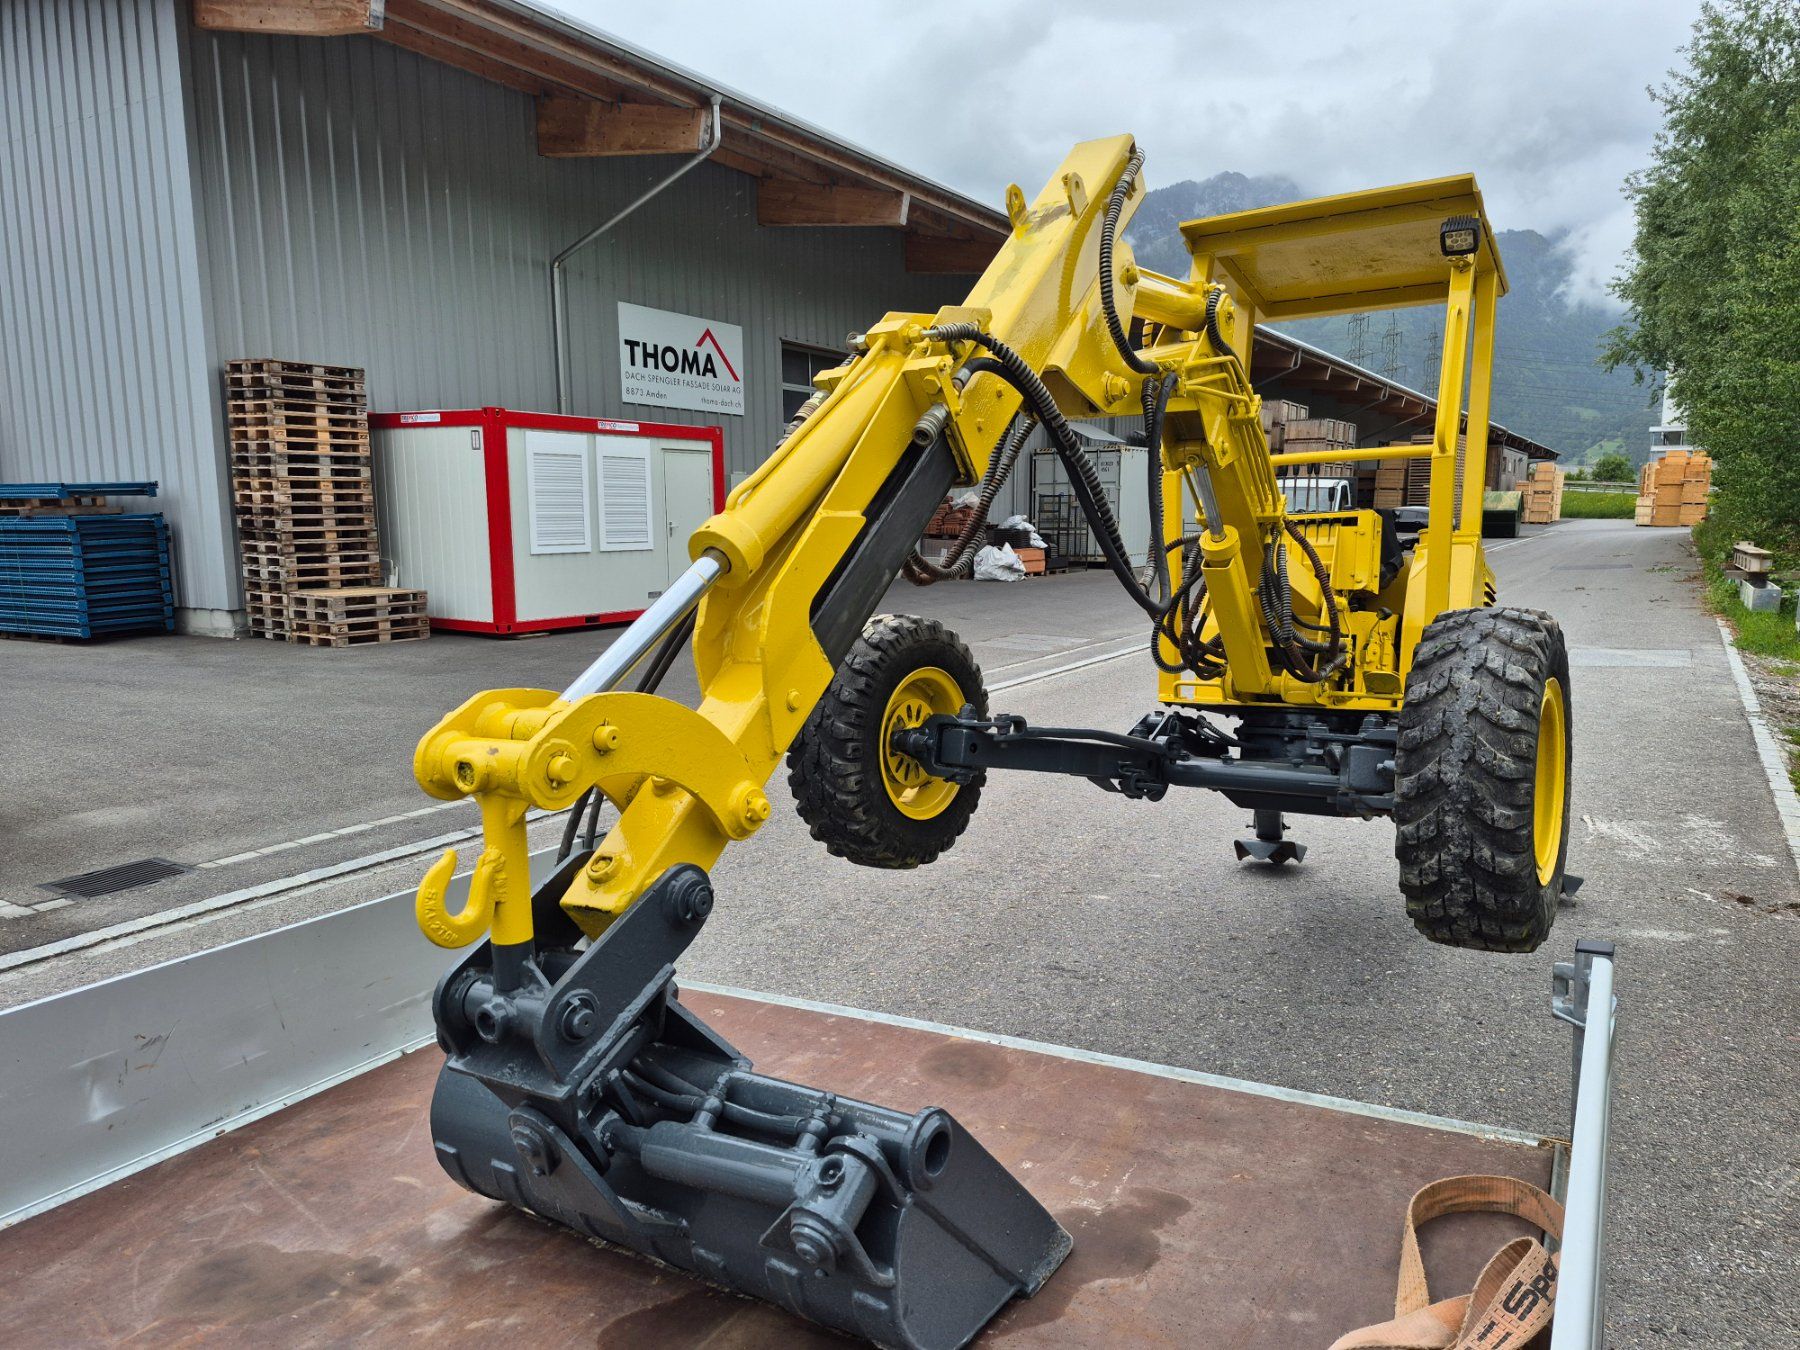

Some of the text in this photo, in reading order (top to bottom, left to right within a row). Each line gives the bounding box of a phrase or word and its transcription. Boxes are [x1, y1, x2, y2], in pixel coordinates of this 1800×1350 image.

[624, 339, 717, 378] THOMA
[625, 371, 741, 394] DACH SPENGLER FASSADE SOLAR AG
[625, 386, 668, 399] 8873 Amden
